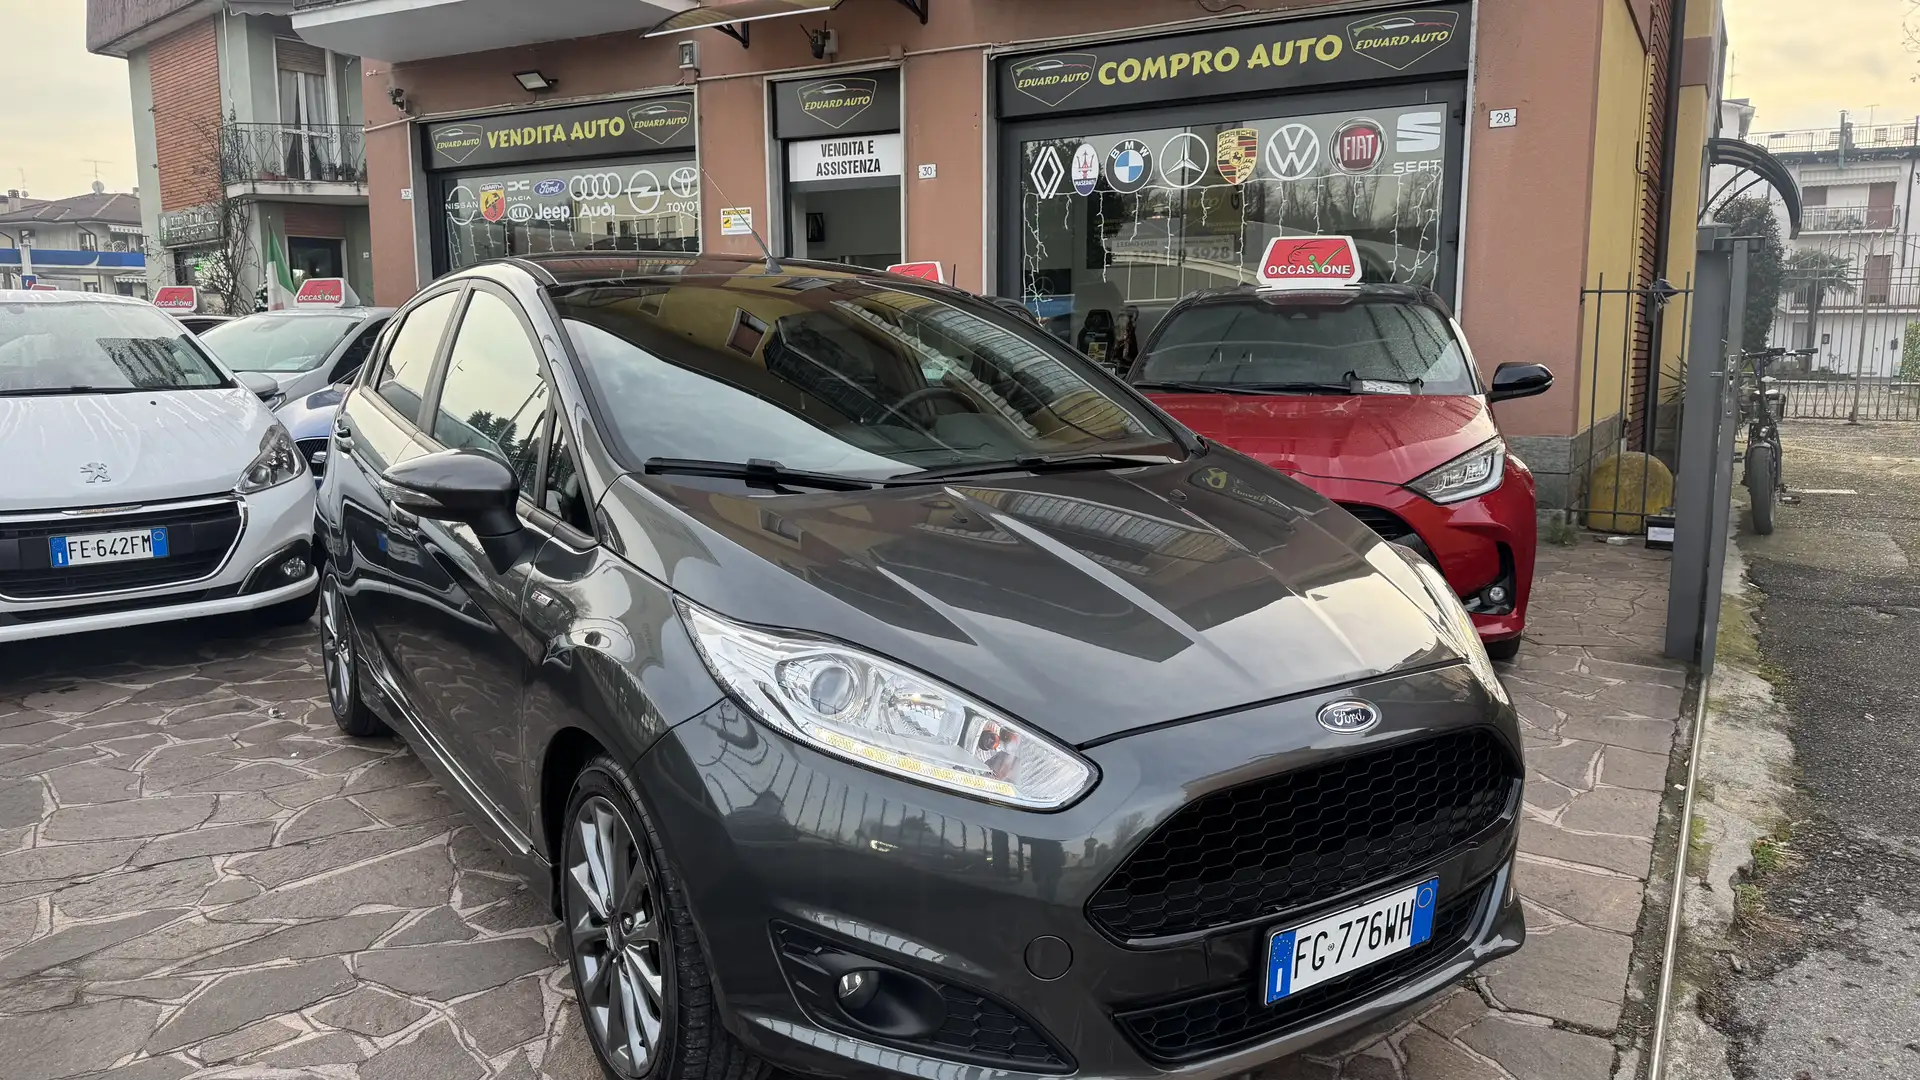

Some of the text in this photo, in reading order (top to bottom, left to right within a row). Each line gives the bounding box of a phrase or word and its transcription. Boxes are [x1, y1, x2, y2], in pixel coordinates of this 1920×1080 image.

[1355, 30, 1449, 50] EDUARD AUTO
[1098, 34, 1343, 86] COMPRO AUTO
[1017, 71, 1090, 89] EDUARD AUTO
[804, 95, 870, 111] EDUARD AUTO
[634, 116, 688, 129] EDUARD AUTO
[1496, 112, 1510, 123] 28
[487, 116, 625, 149] VENDITA AUTO
[1219, 130, 1257, 141] PORSCHE
[437, 138, 480, 149] EDUARD AUTO
[821, 139, 874, 158] VENDITA E
[1110, 141, 1150, 159] BMW
[1343, 134, 1375, 161] FIAT
[816, 158, 881, 177] ASSISTENZA
[922, 166, 933, 176] 30
[1393, 159, 1441, 174] SEAT
[539, 181, 560, 194] Ford
[445, 201, 479, 210] NISSAN
[511, 209, 529, 218] KIA
[534, 203, 570, 222] Jeep
[579, 202, 615, 217] Audi
[1333, 707, 1365, 726] Ford
